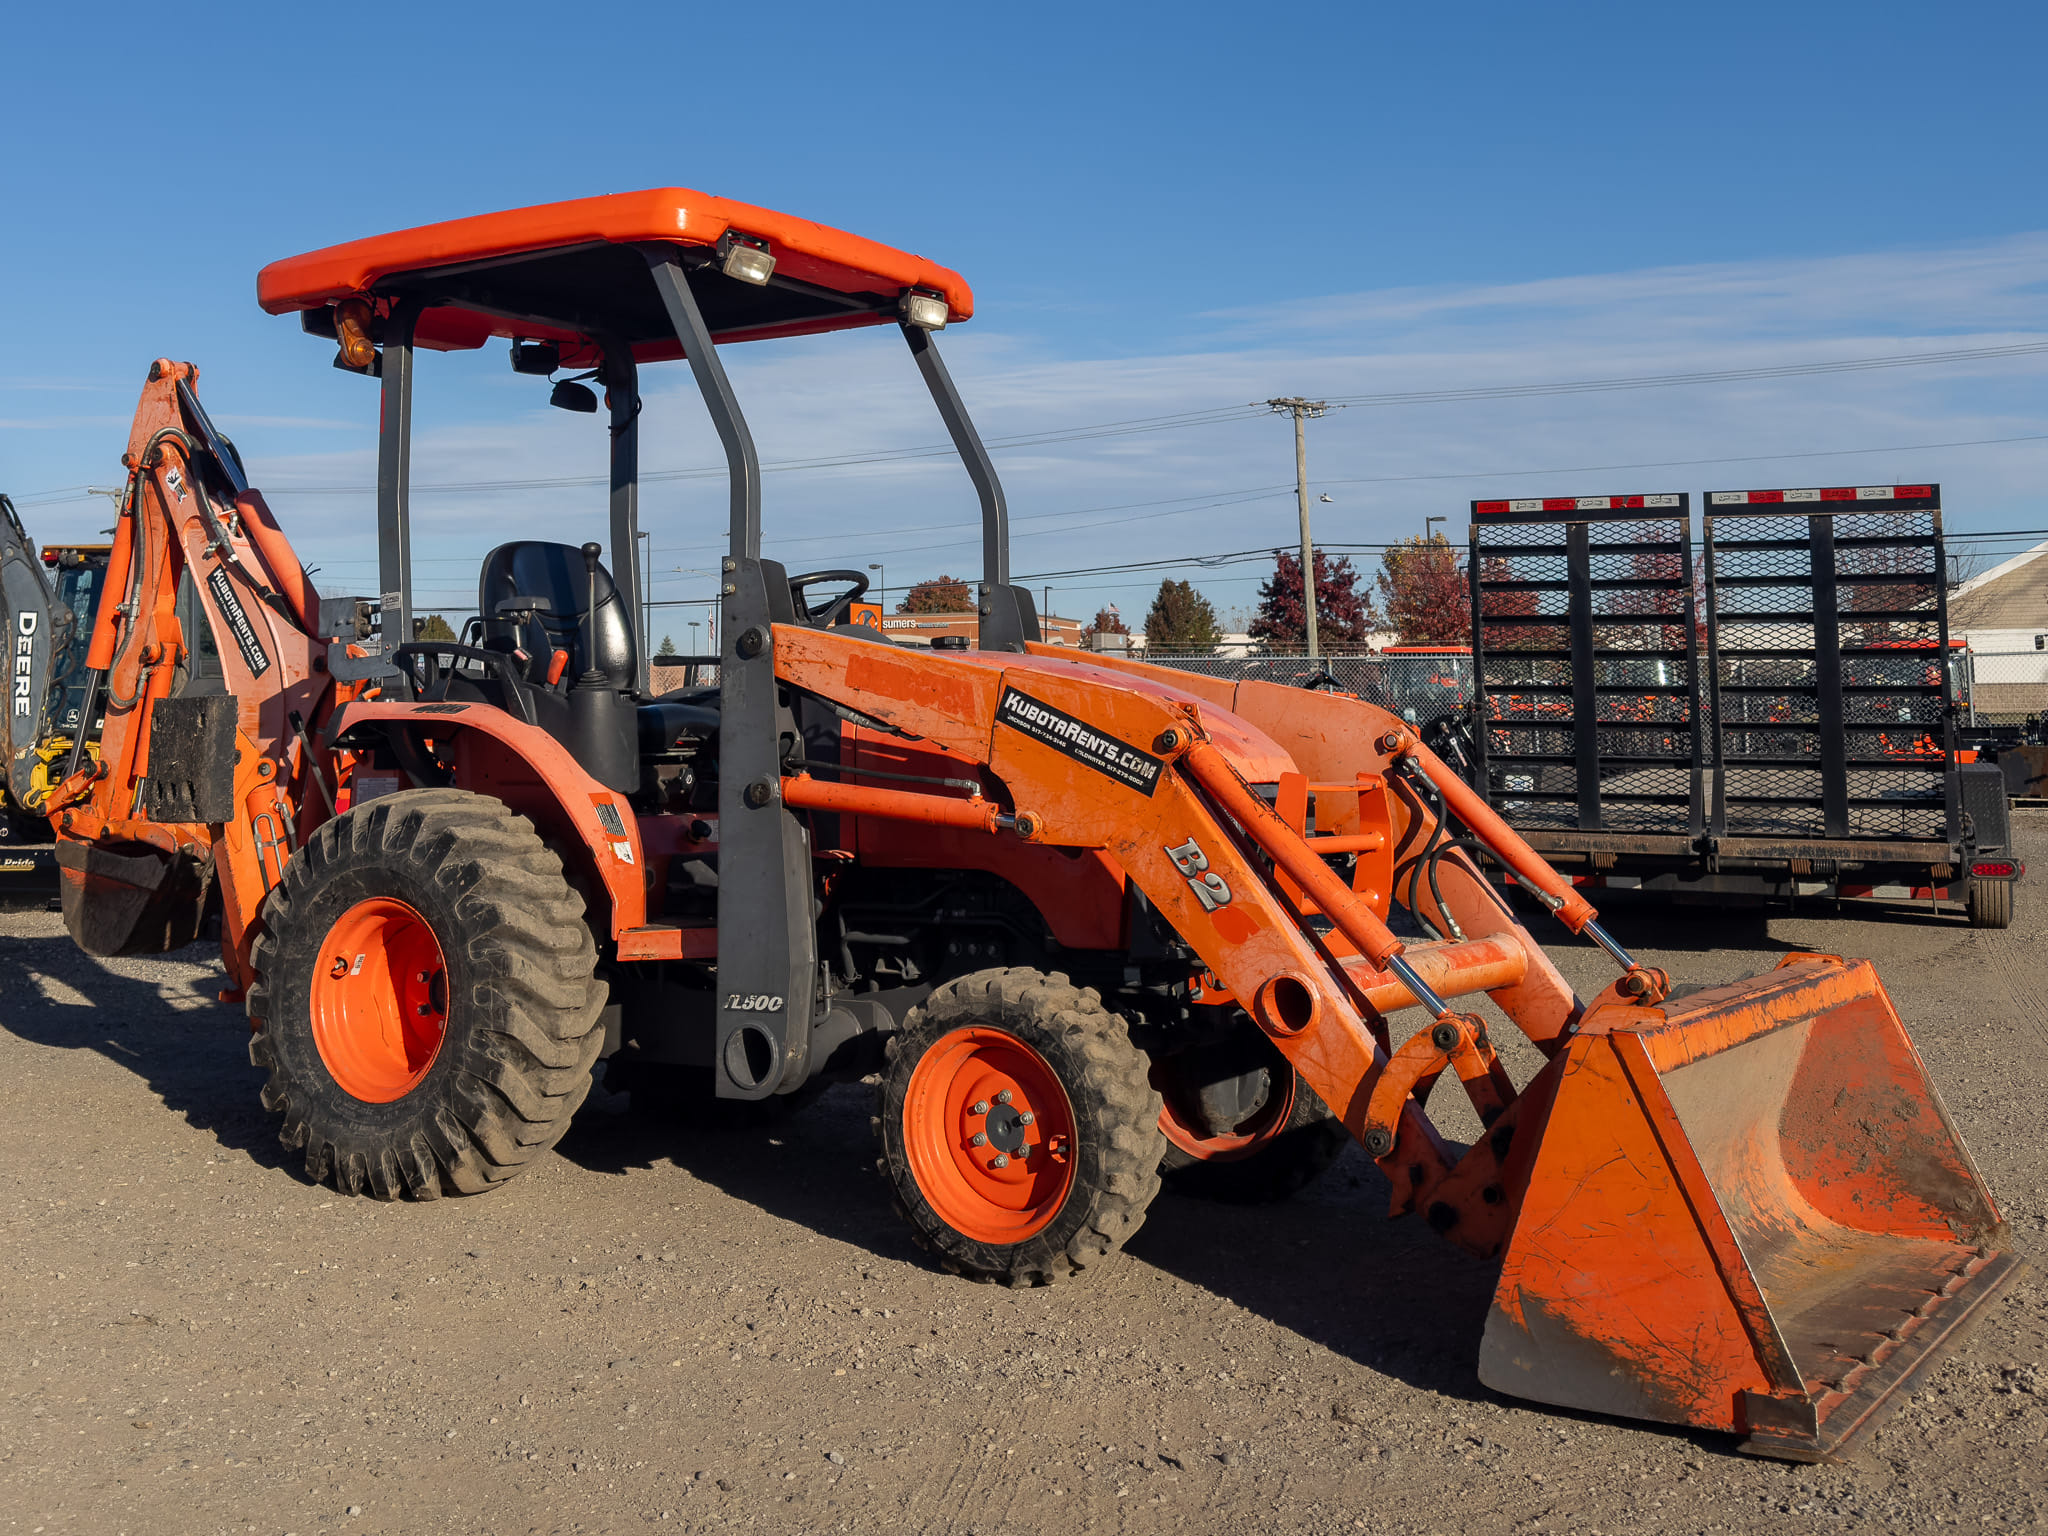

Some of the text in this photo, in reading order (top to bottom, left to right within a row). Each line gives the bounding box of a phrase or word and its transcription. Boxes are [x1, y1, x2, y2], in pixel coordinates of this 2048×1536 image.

[15, 611, 38, 716] DEERE
[213, 568, 267, 670] KUBOTARENTS.COM
[1004, 692, 1158, 780] KUBOTARENTS.COM
[1074, 748, 1106, 767] COLDWATER
